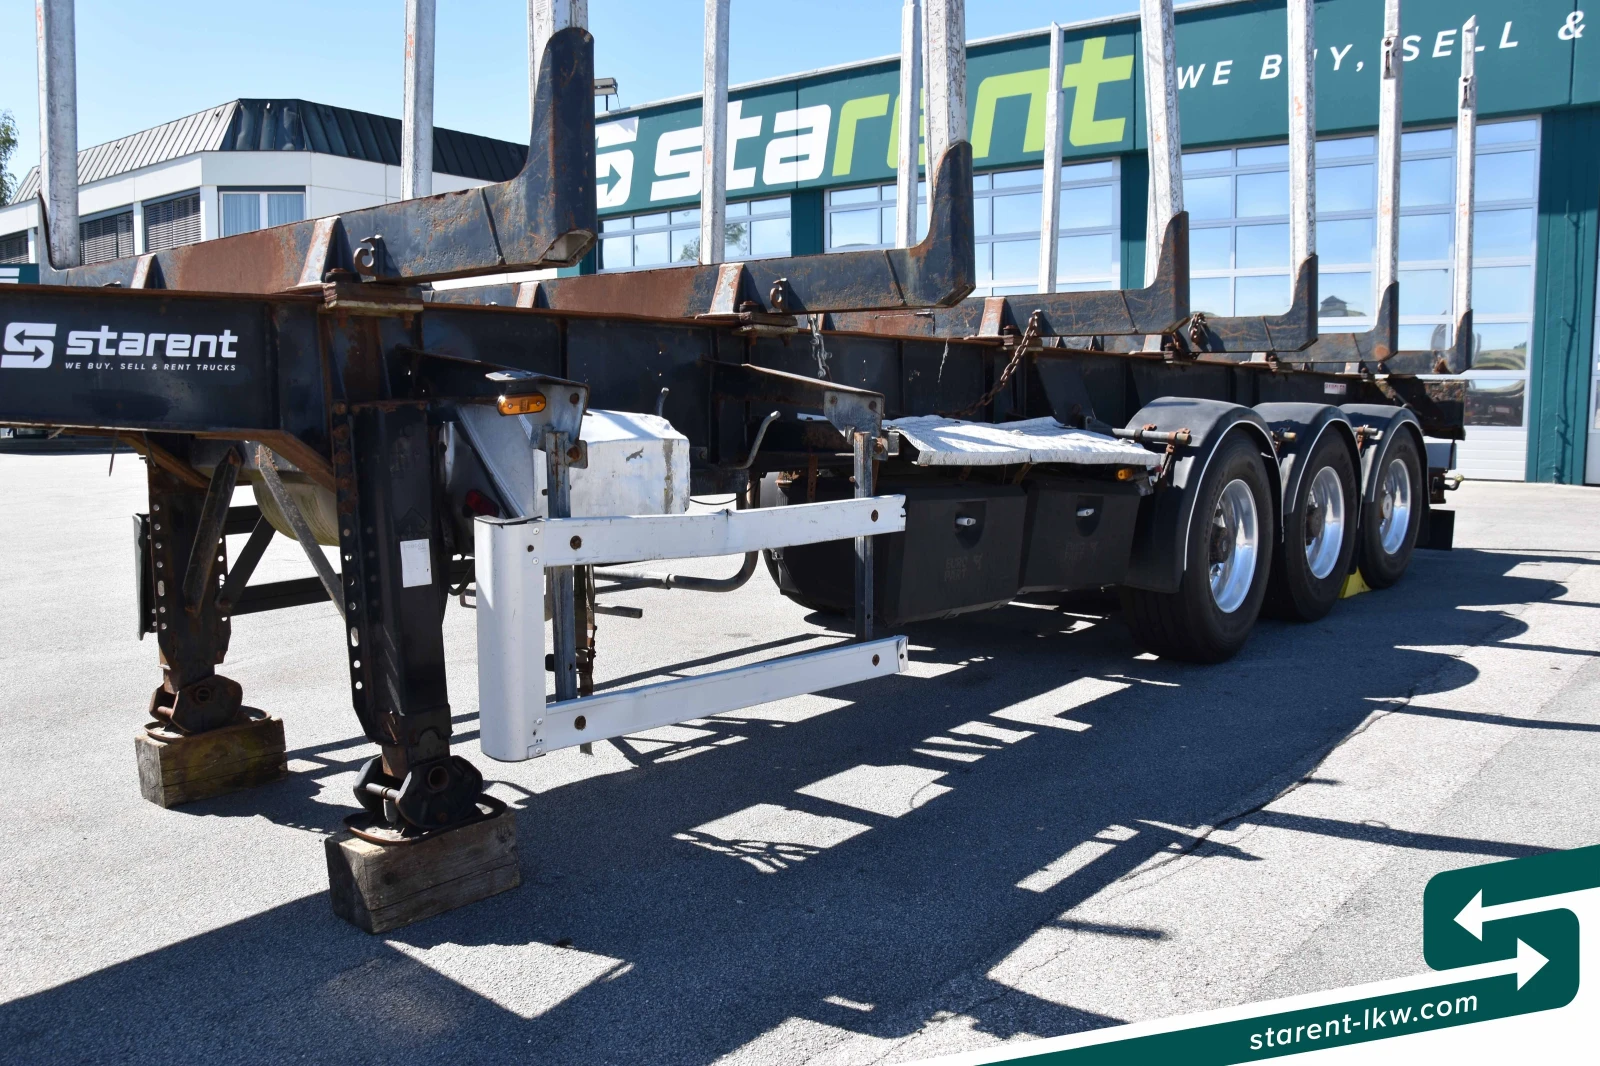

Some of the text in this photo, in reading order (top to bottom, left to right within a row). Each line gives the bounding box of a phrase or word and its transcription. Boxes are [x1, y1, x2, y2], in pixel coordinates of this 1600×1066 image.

[1176, 59, 1233, 90] WE
[1260, 43, 1364, 80] BY,
[1557, 10, 1586, 41] &
[66, 325, 238, 358] starent
[65, 362, 236, 371] WE BUY, SELL & RENT TRUCKS
